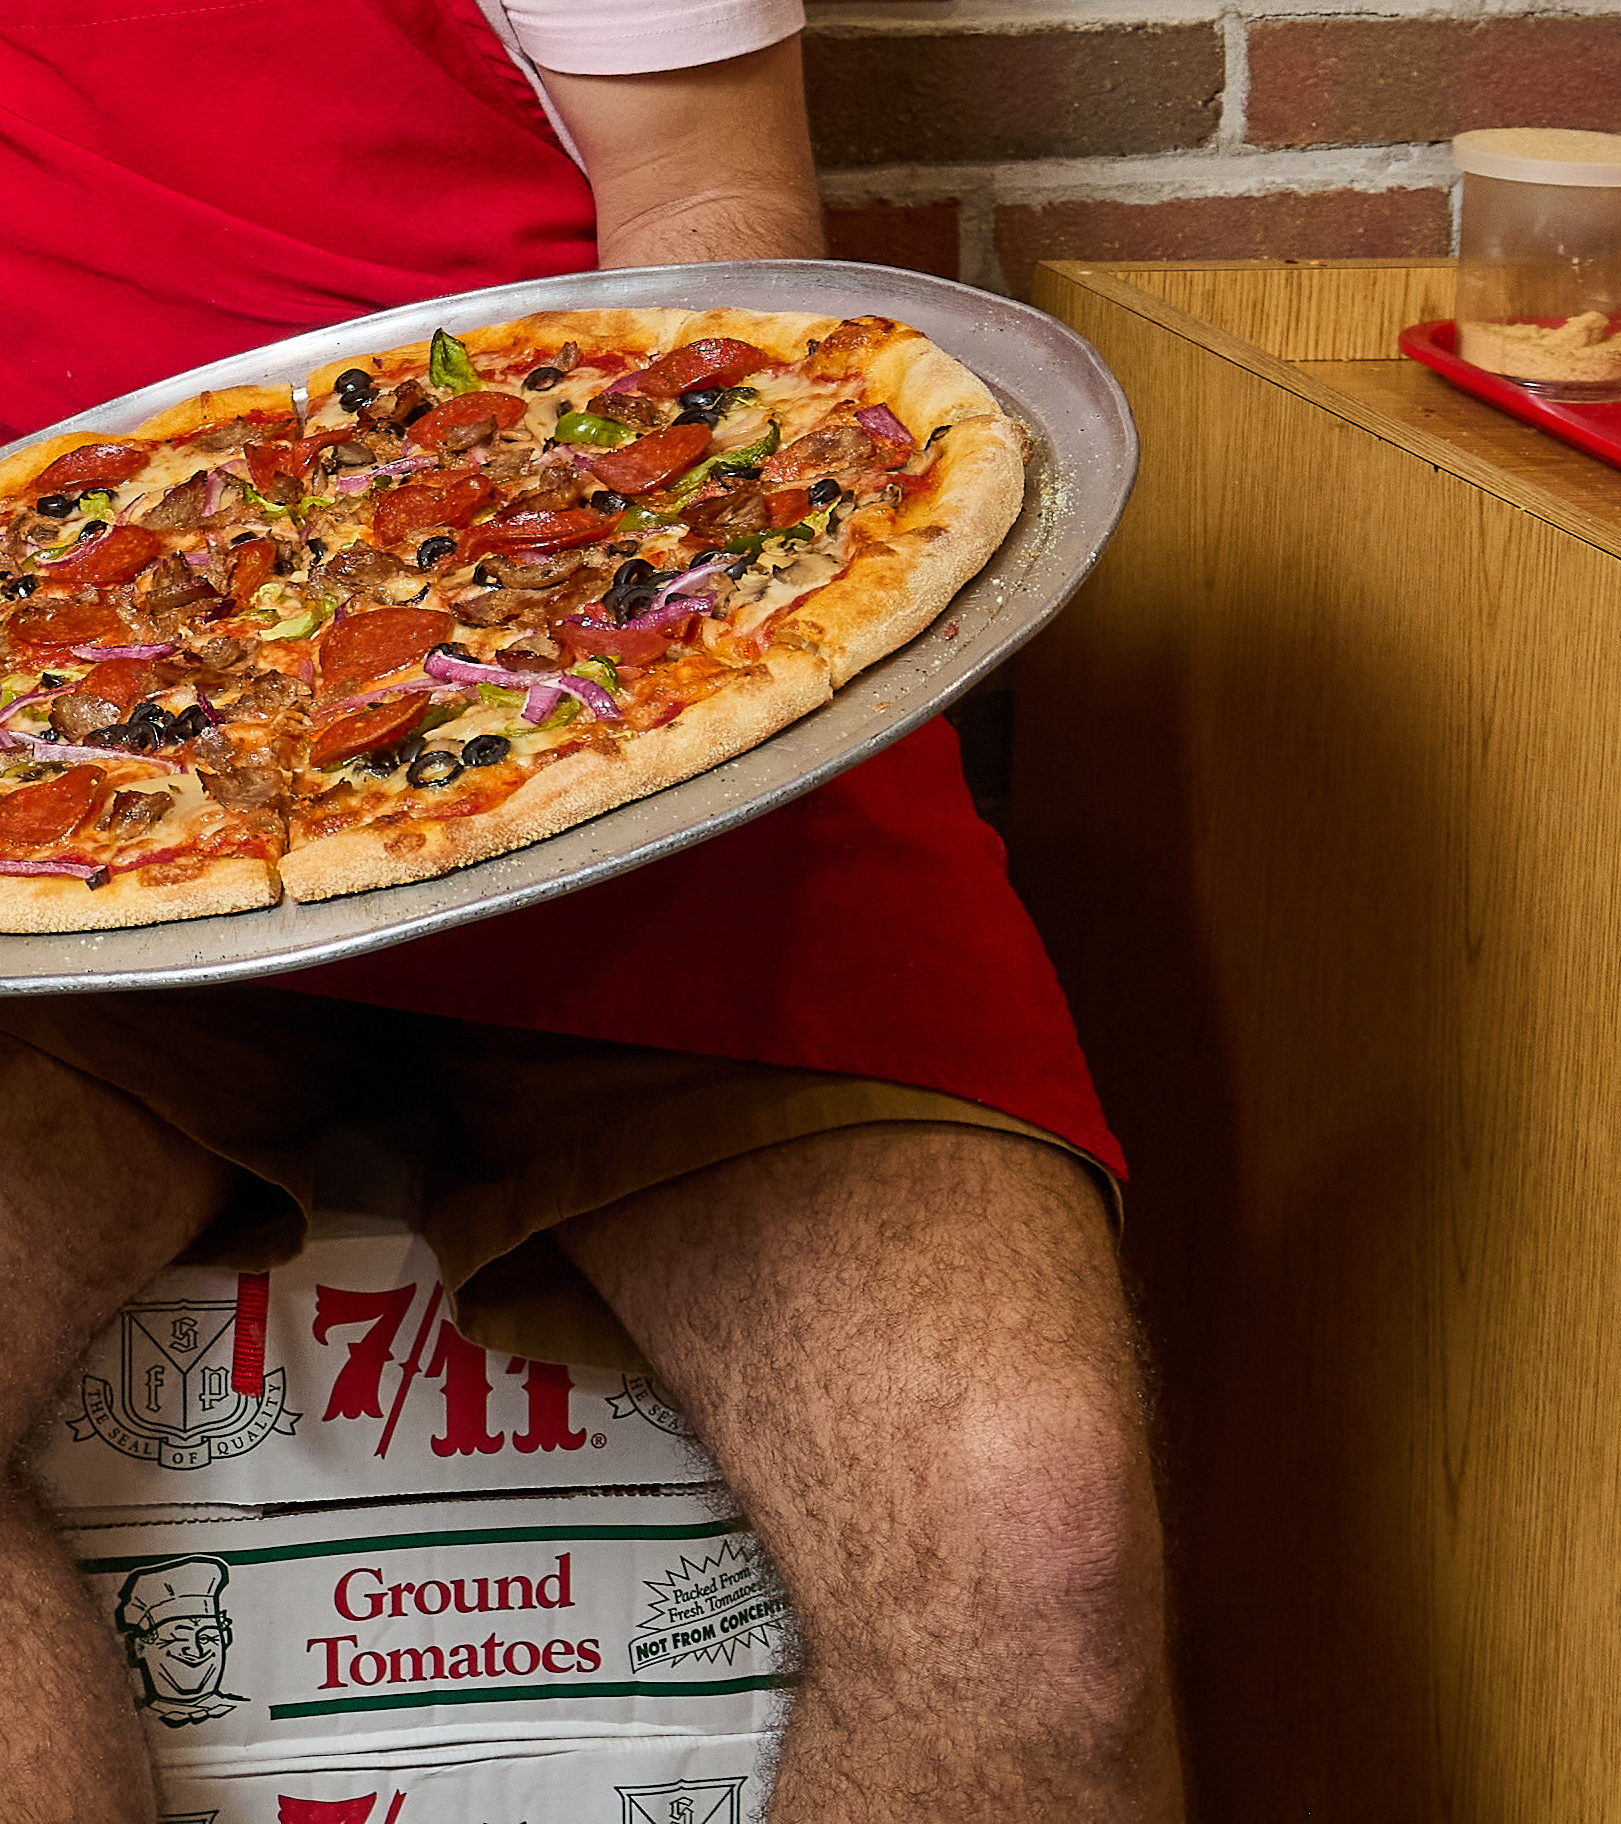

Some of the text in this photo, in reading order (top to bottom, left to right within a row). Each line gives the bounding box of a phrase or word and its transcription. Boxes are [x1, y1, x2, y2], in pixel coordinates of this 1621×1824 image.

[86, 1383, 282, 1465] THE SEAL OF QUALITY
[333, 1551, 576, 1622] Ground
[672, 1566, 752, 1605] Packed From
[667, 1603, 706, 1624] Fresh
[306, 1632, 602, 1690] Tomatoes
[635, 1637, 669, 1662] NOT
[671, 1625, 717, 1650] FROM
